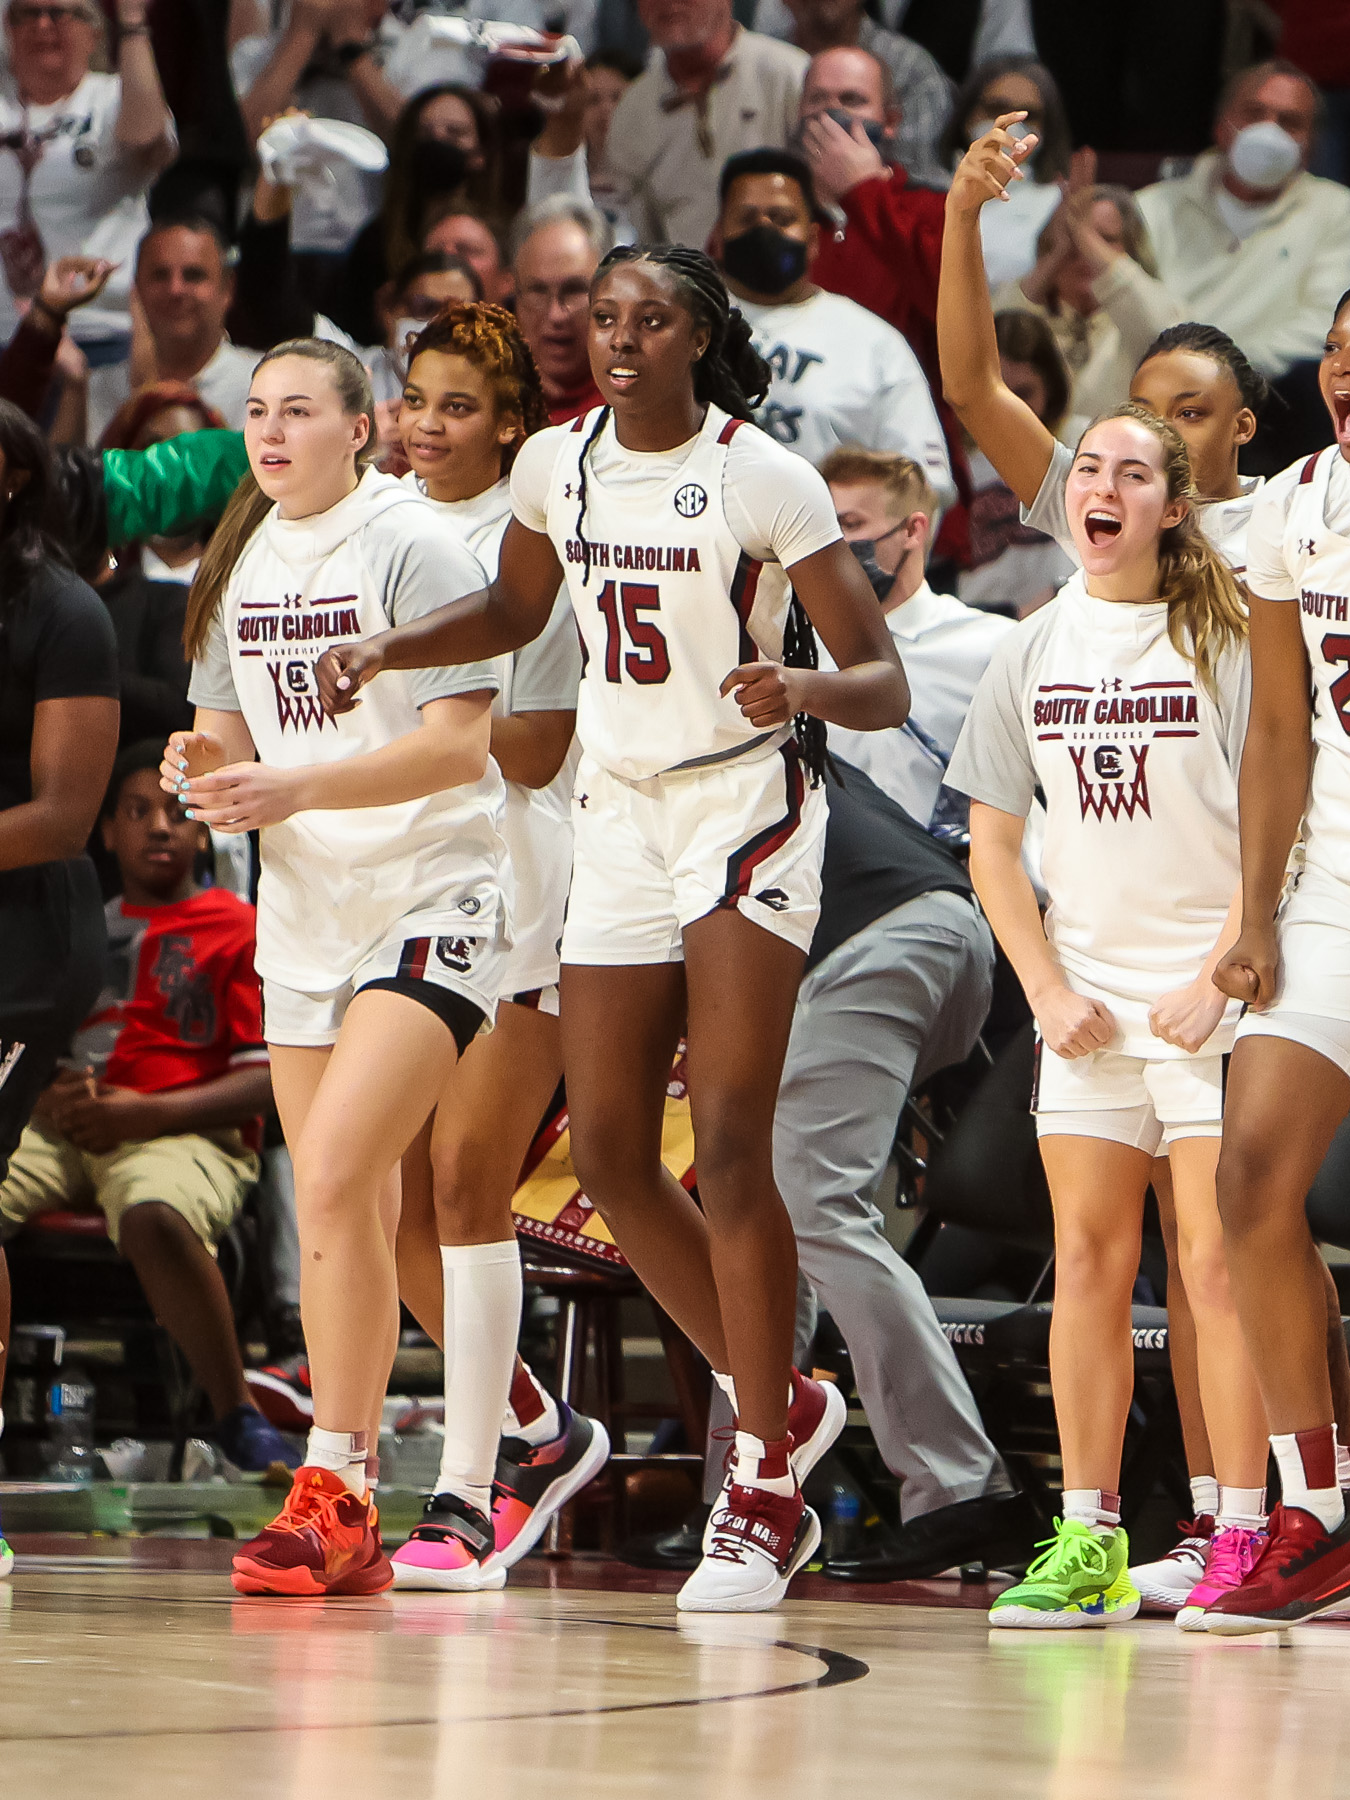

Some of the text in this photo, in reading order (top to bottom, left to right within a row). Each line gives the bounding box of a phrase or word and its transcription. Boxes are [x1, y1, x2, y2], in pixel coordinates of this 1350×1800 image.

[674, 483, 708, 518] SEC
[565, 539, 701, 573] SOTH CAROLINA
[238, 615, 279, 642] OUTH
[597, 579, 671, 685] 15
[1033, 695, 1199, 726] SOUTH CAROLINA
